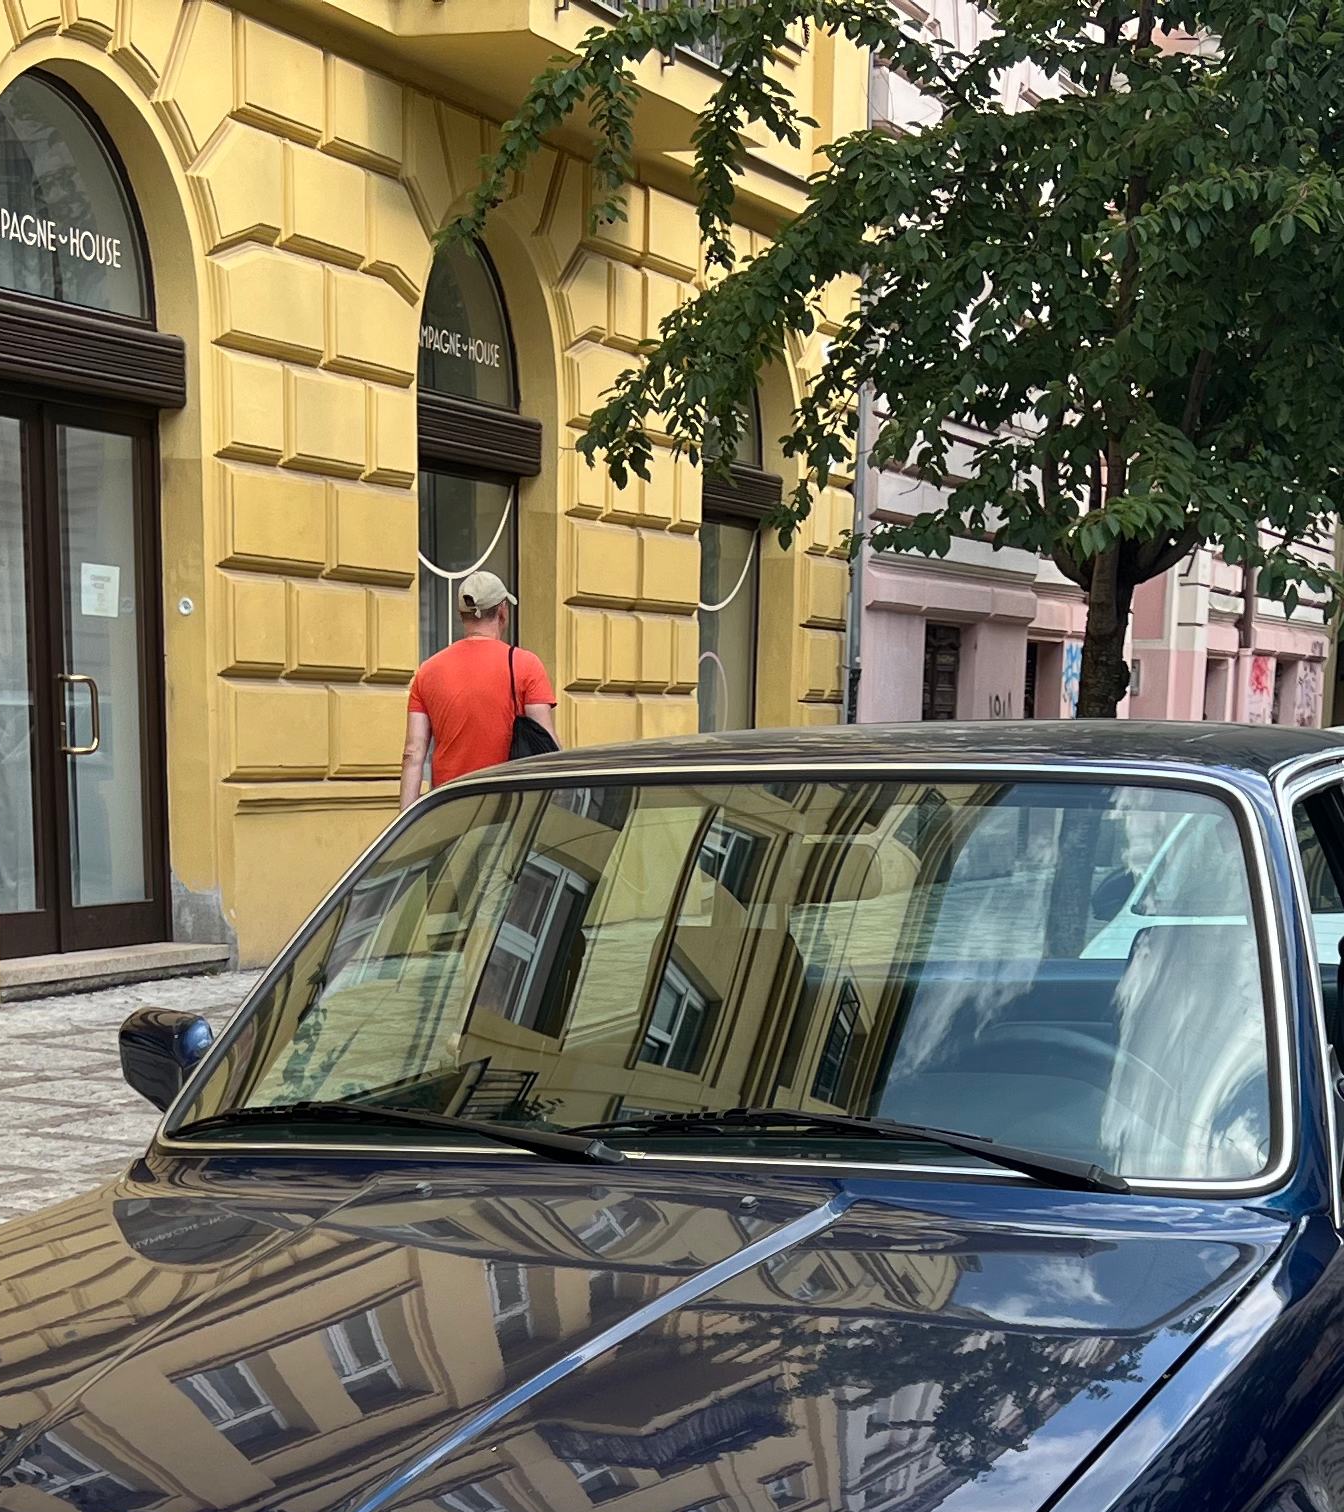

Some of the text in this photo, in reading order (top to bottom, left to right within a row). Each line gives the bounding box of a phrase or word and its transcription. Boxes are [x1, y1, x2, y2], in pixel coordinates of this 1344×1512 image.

[69, 227, 121, 268] HOUSE
[419, 325, 500, 368] MPAGNE HOUSE
